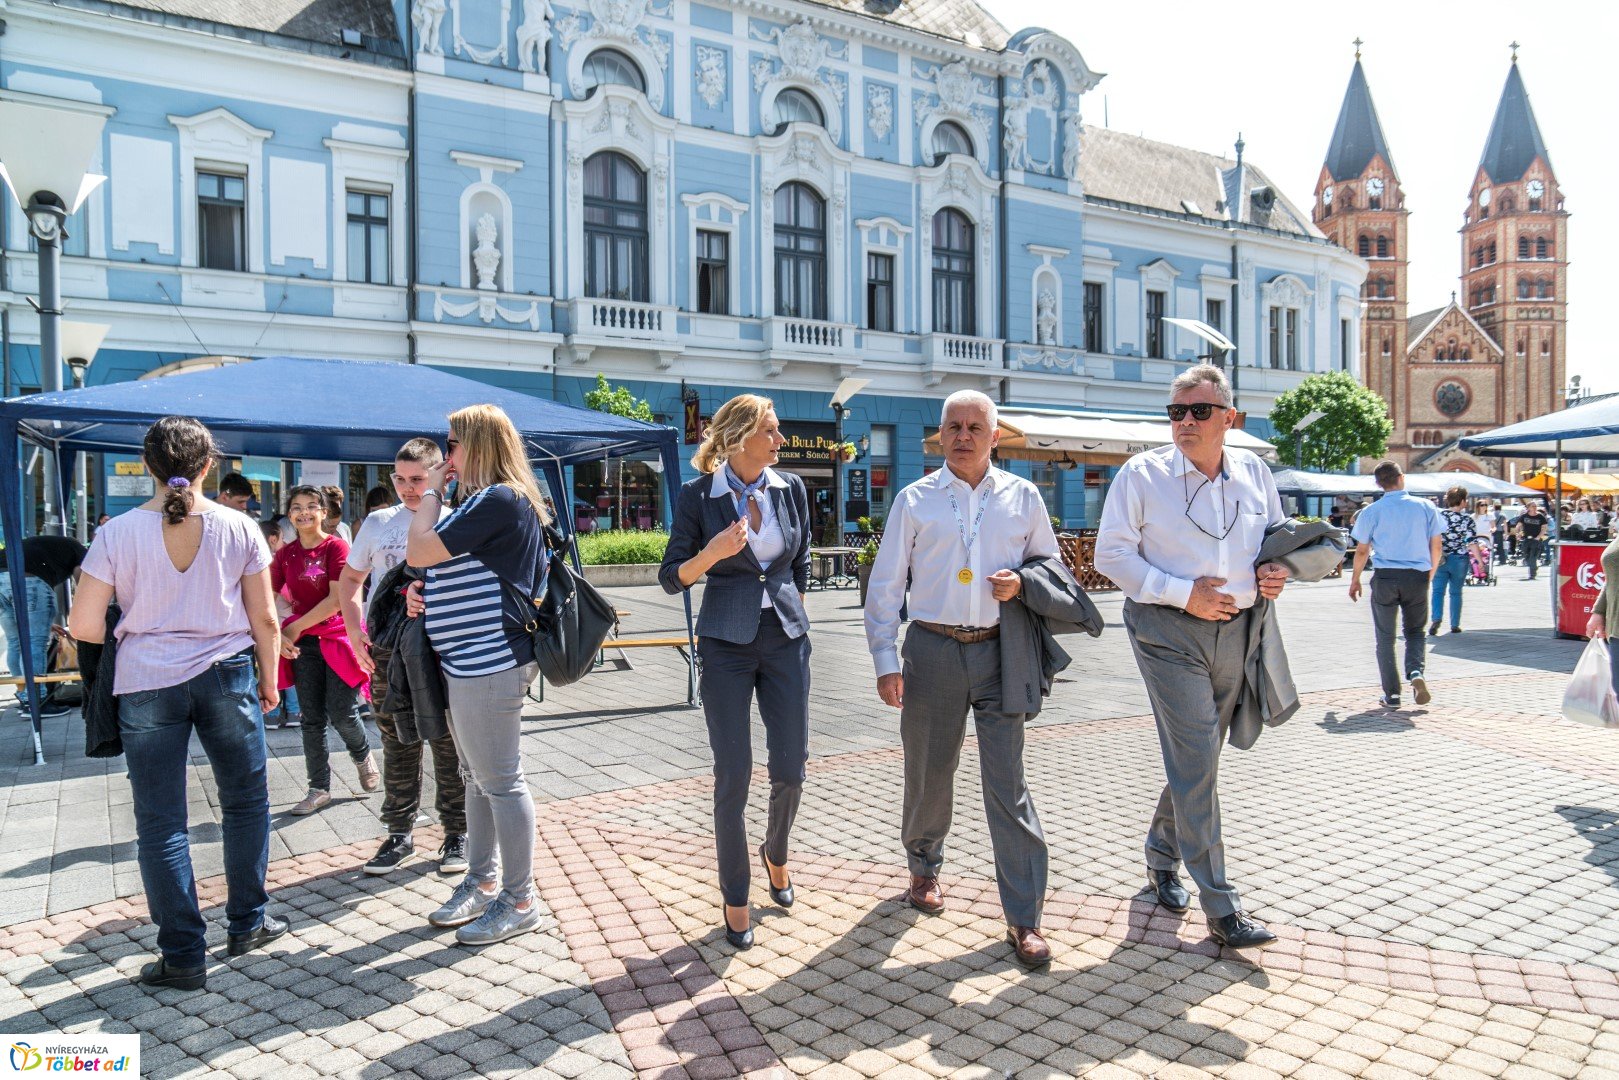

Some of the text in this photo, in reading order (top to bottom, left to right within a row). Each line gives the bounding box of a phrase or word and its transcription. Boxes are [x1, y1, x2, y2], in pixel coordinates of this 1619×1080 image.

[686, 404, 696, 430] X
[792, 435, 815, 448] BULL
[816, 436, 834, 448] PUB
